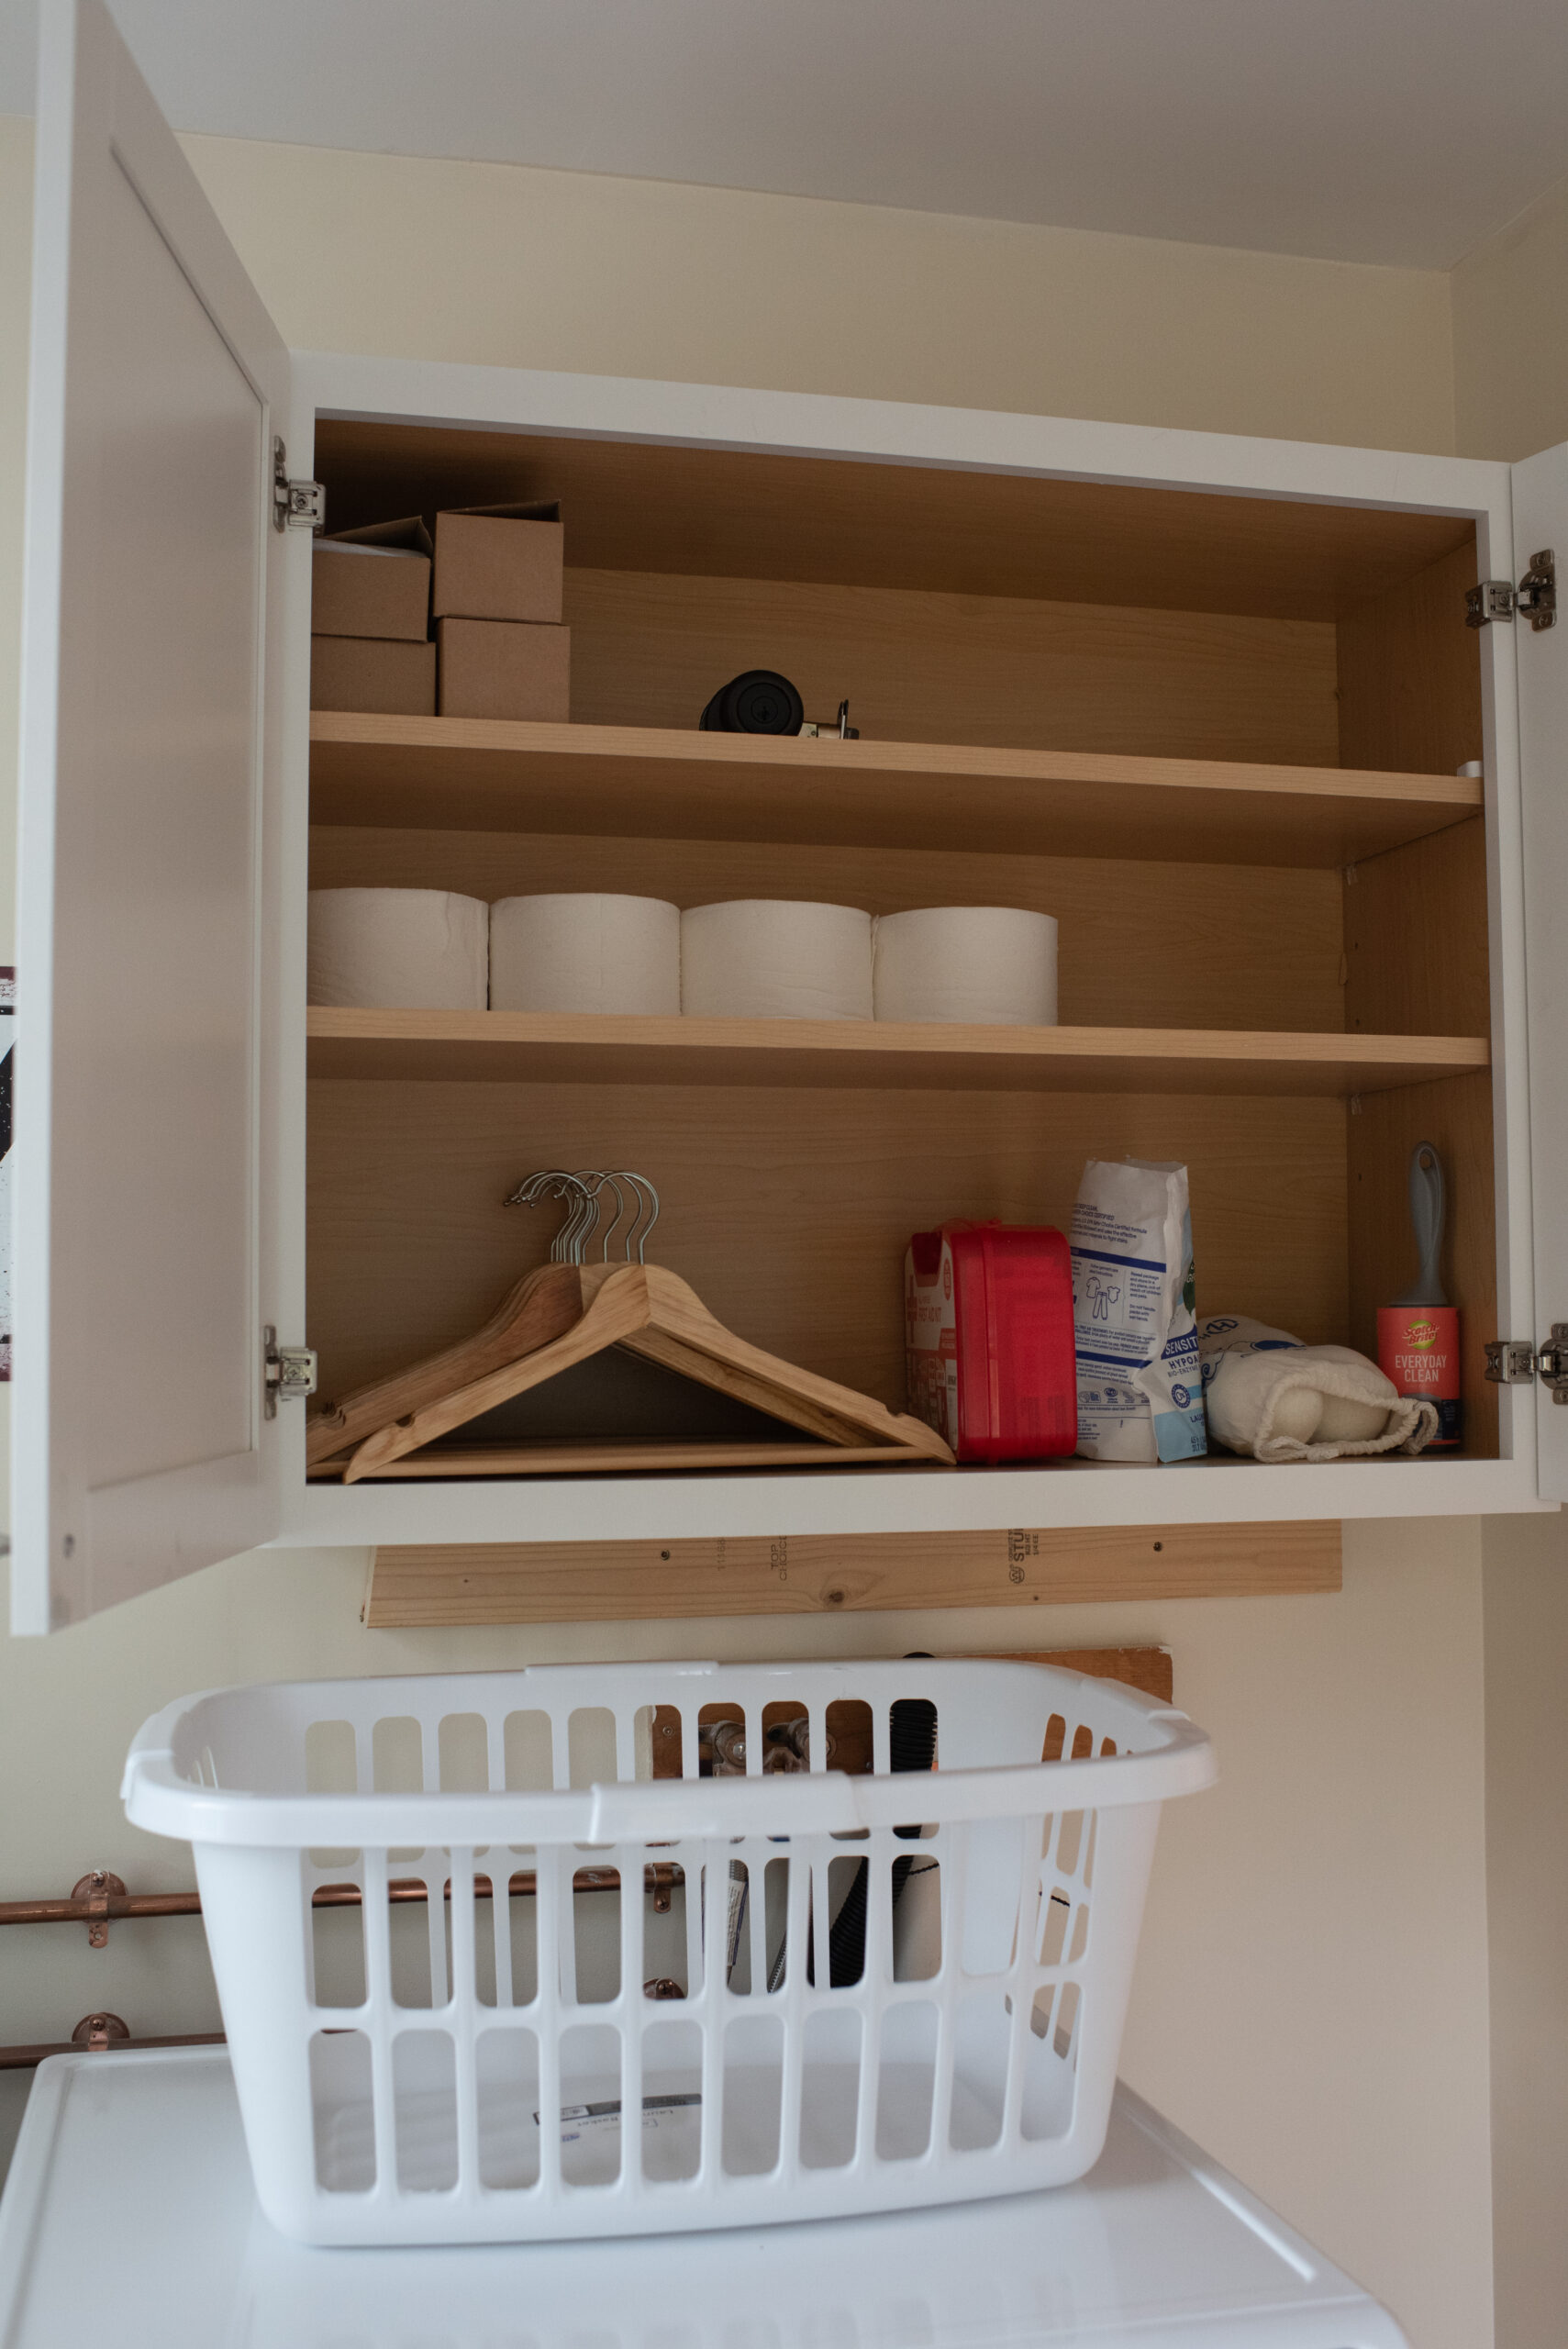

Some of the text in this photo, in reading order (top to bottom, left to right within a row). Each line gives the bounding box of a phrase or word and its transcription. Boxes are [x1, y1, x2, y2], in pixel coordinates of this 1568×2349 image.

[1407, 1331, 1436, 1345] Brite
[1396, 1354, 1447, 1368] EVERYDAY
[1405, 1369, 1440, 1383] CLEAN
